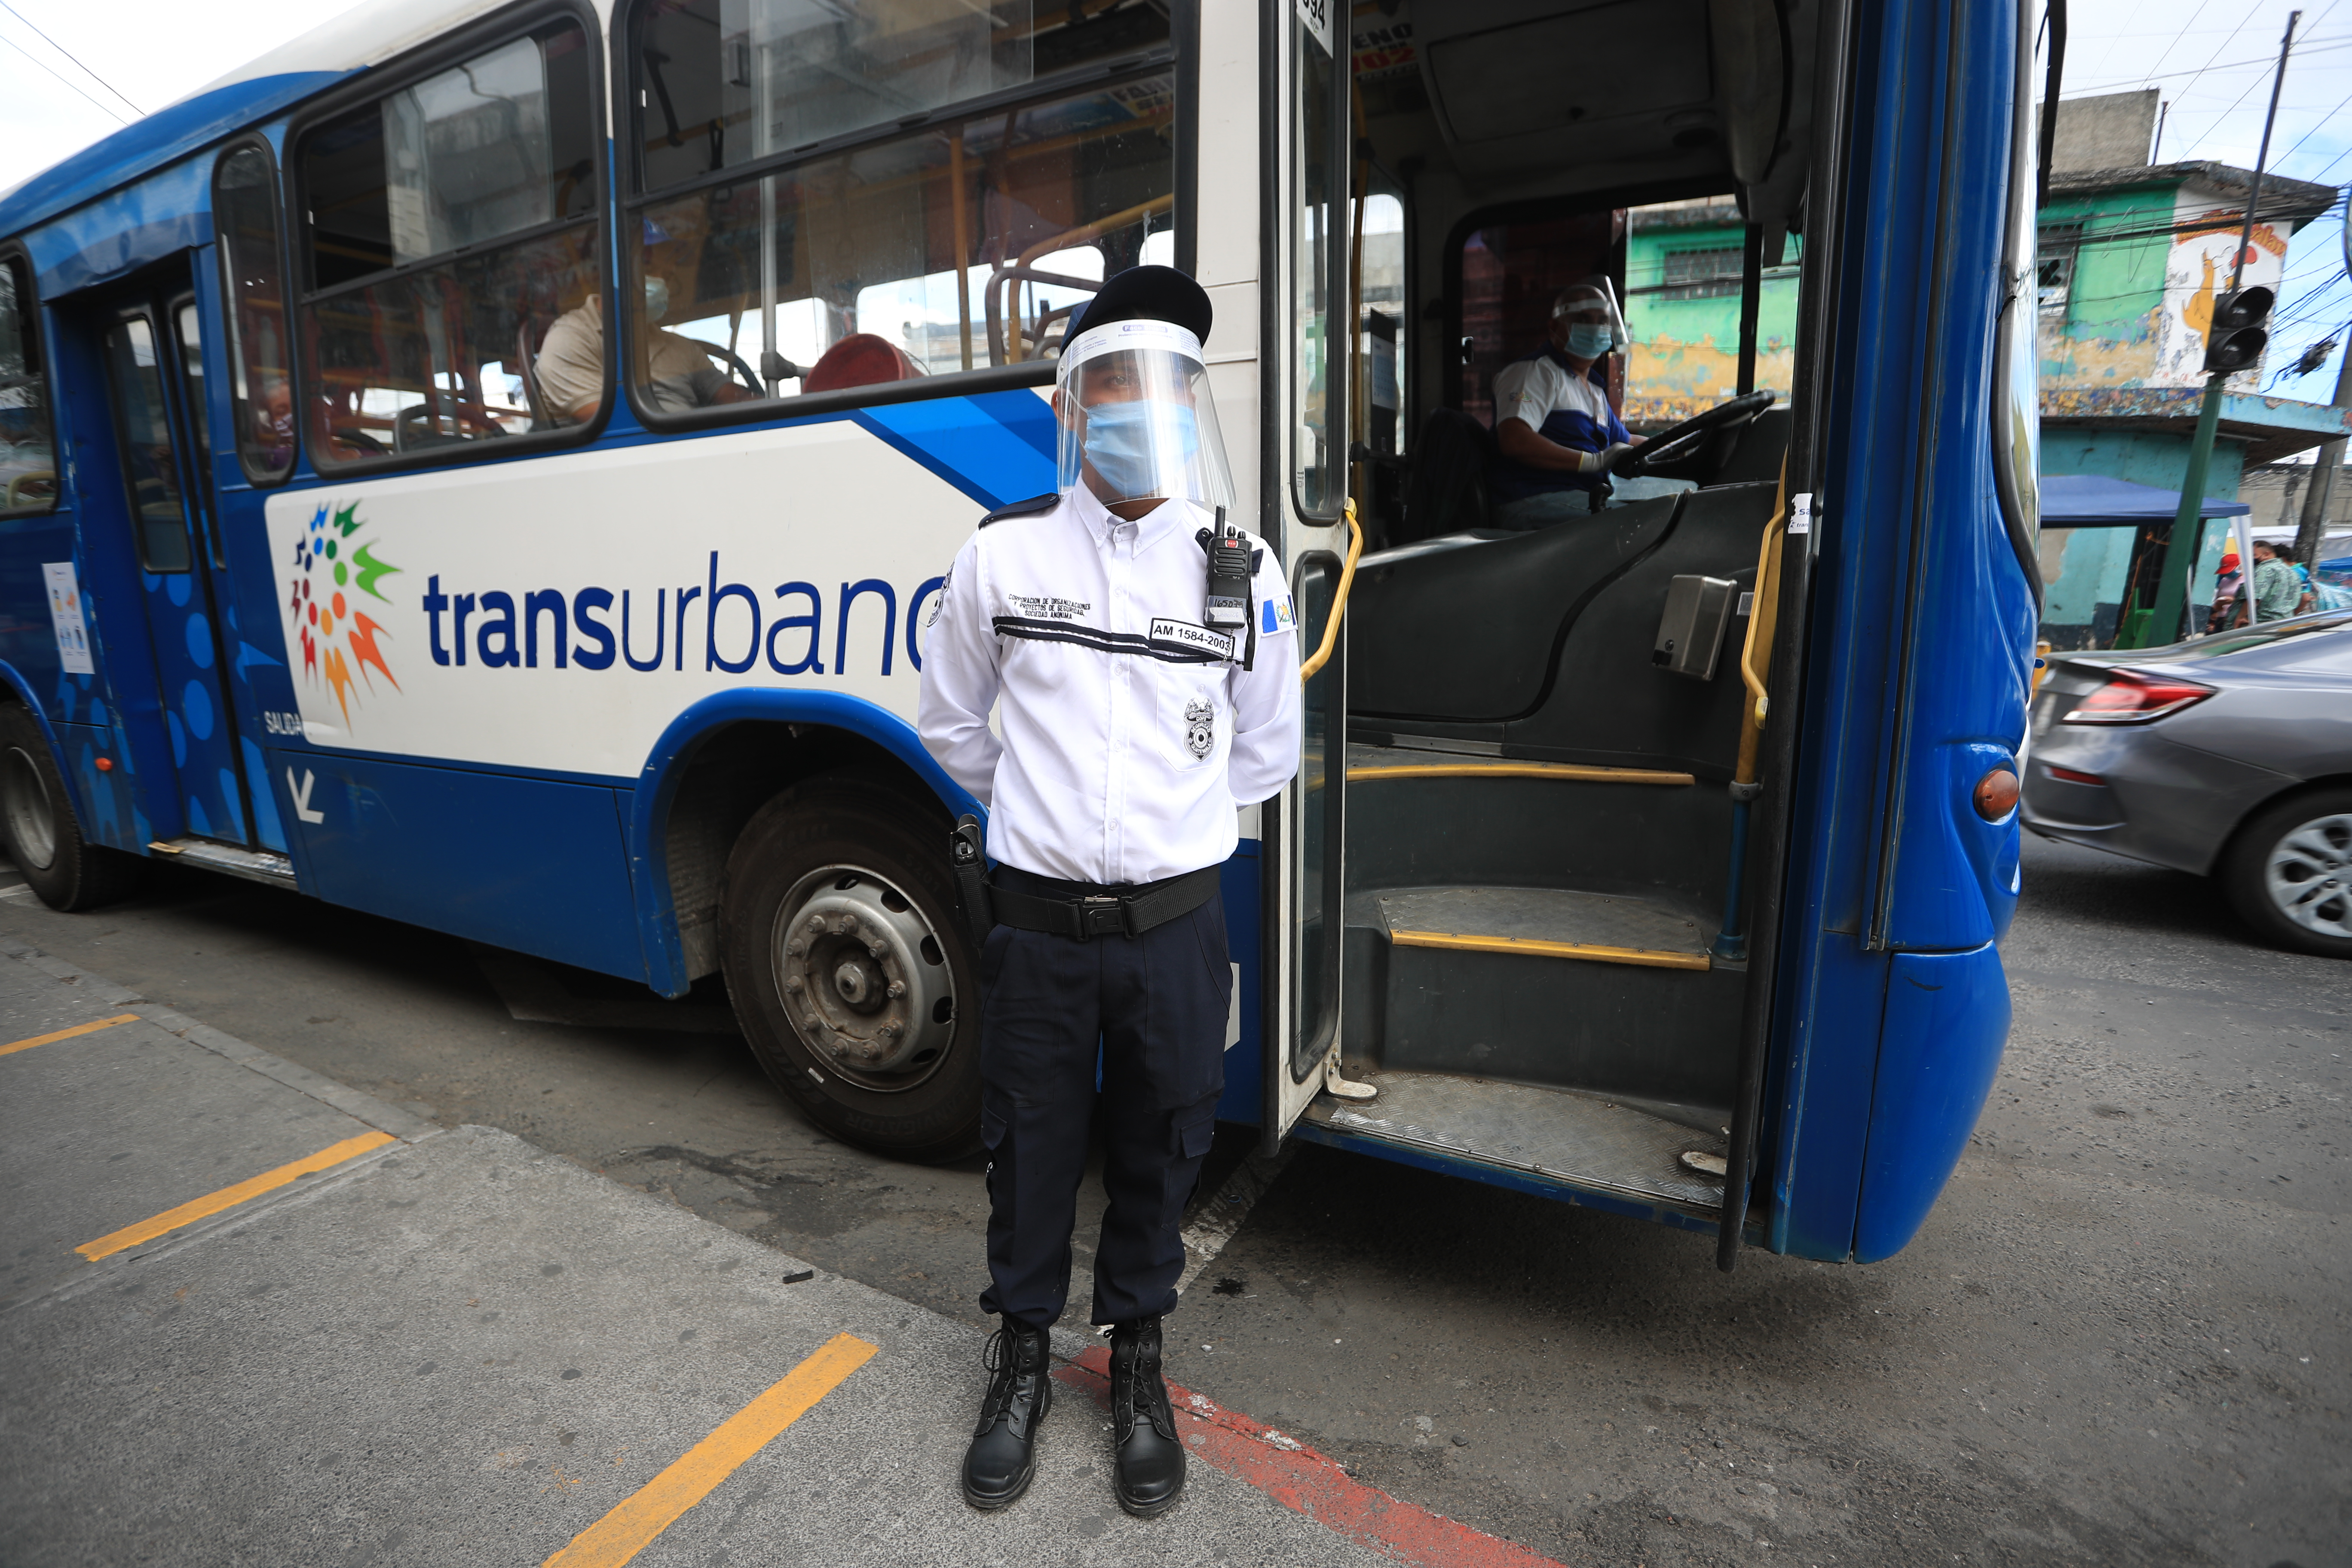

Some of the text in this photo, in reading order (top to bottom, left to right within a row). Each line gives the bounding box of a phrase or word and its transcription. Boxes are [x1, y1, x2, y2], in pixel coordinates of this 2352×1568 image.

[1303, 0, 1325, 31] 94
[1008, 594, 1040, 604] CORPORACION
[1051, 597, 1090, 610] ORGANIZACIONES
[1050, 611, 1072, 619] ANONIMA
[1153, 625, 1231, 651] AM 1584-2003
[263, 710, 305, 736] SALIDA
[1191, 722, 1211, 733] SEGURIDAD
